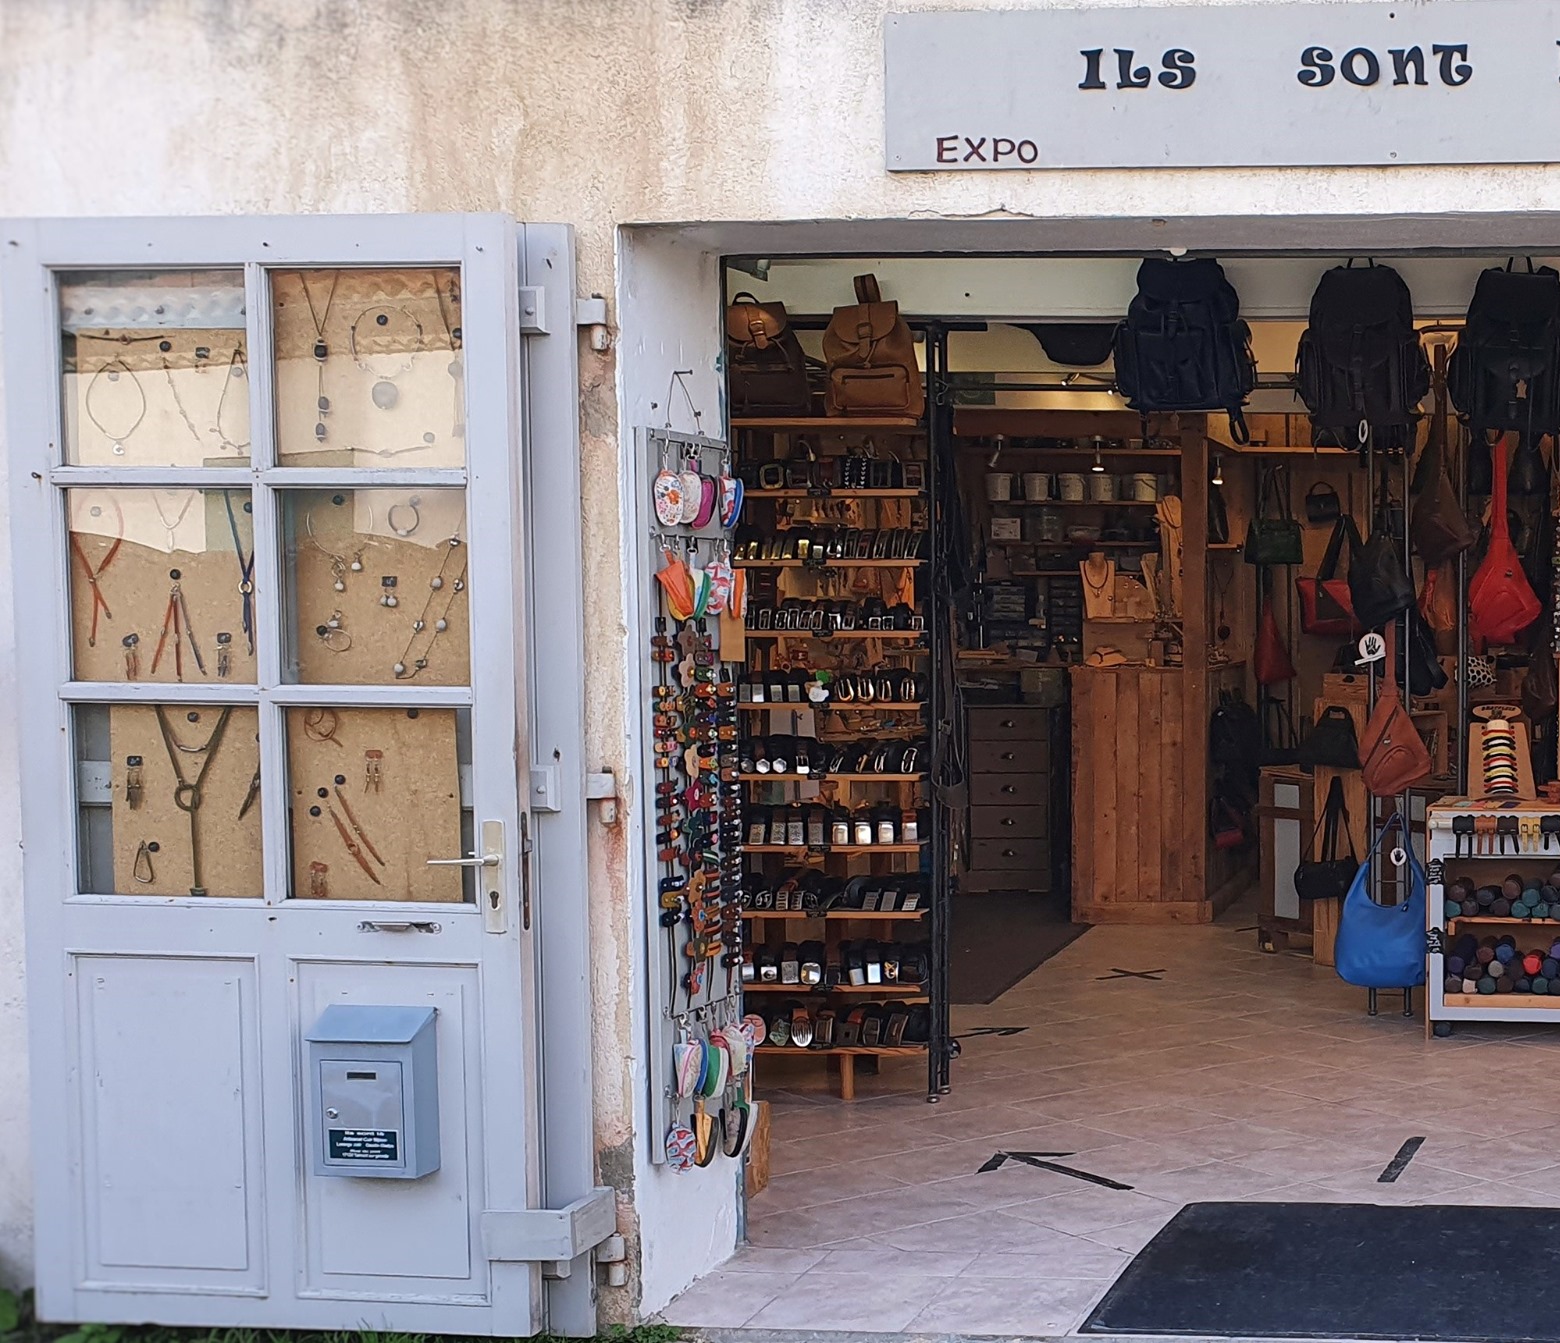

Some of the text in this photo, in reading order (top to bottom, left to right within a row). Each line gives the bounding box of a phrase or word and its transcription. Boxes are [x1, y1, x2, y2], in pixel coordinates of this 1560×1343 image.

[1077, 48, 1197, 91] ILS
[1296, 43, 1474, 88] SONT
[935, 136, 1039, 164] EXPO
